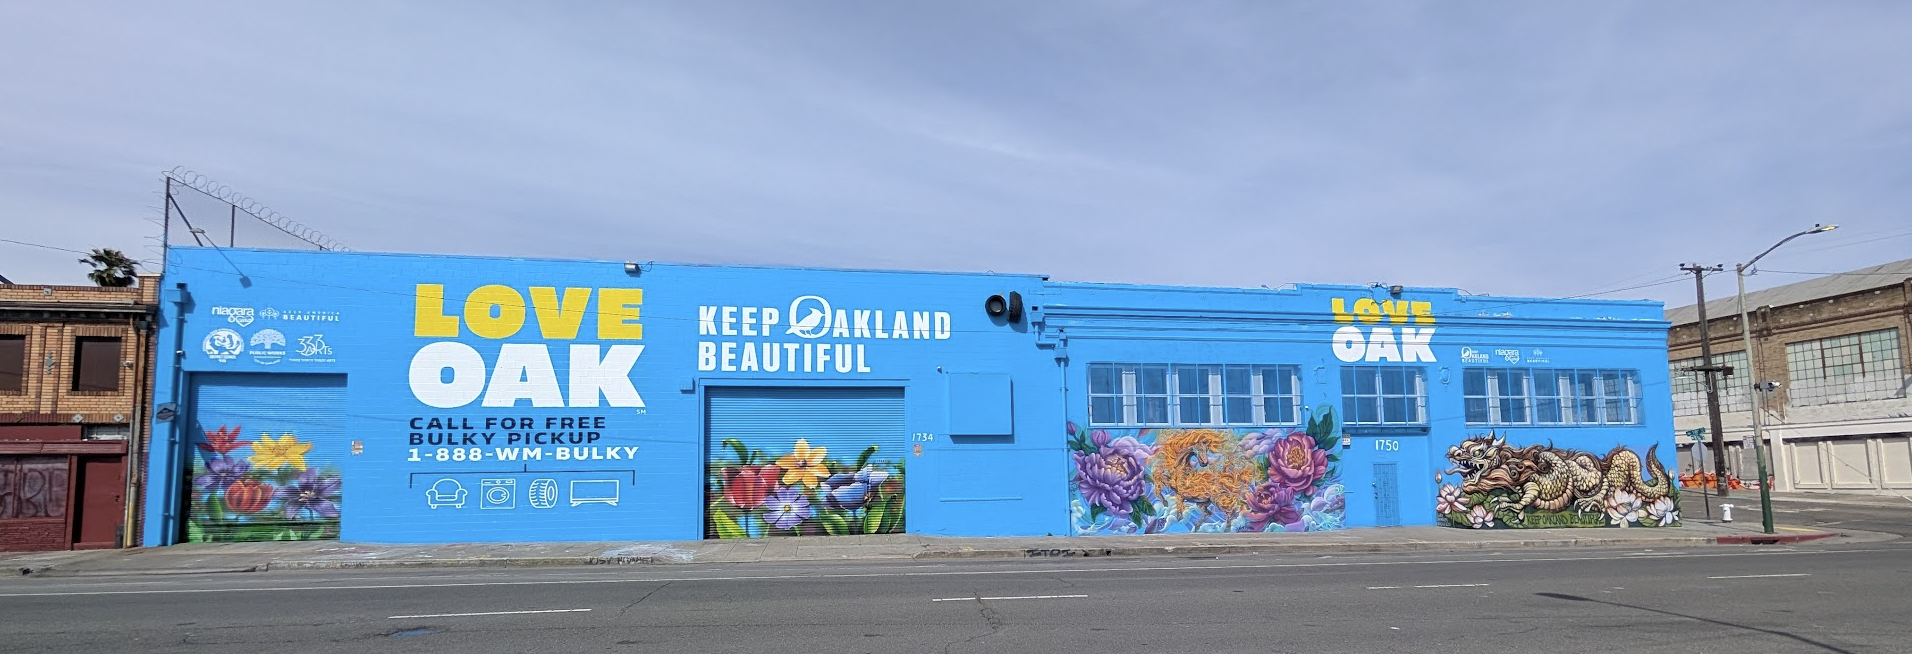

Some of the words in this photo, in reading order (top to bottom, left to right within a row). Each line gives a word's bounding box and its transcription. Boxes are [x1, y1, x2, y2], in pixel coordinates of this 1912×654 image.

[212, 306, 254, 319] niagara
[414, 284, 643, 340] LOVE
[699, 305, 780, 337] KEEP
[785, 295, 951, 340] OAKLAND
[1331, 298, 1436, 325] LOVE
[1332, 326, 1437, 363] OAK
[698, 341, 871, 373] BEAUTIFUL
[1496, 348, 1520, 357] niagara
[408, 341, 646, 409] OAK
[409, 417, 474, 430] CALL
[485, 417, 535, 430] FOR
[545, 416, 606, 429] FREE
[409, 432, 496, 446] BULKY
[507, 431, 601, 445] PICKUP
[912, 432, 933, 442] 1734
[1375, 439, 1399, 452] 1750
[407, 446, 639, 462] 1-888-WM-BULKY
[1526, 513, 1542, 526] KEEP
